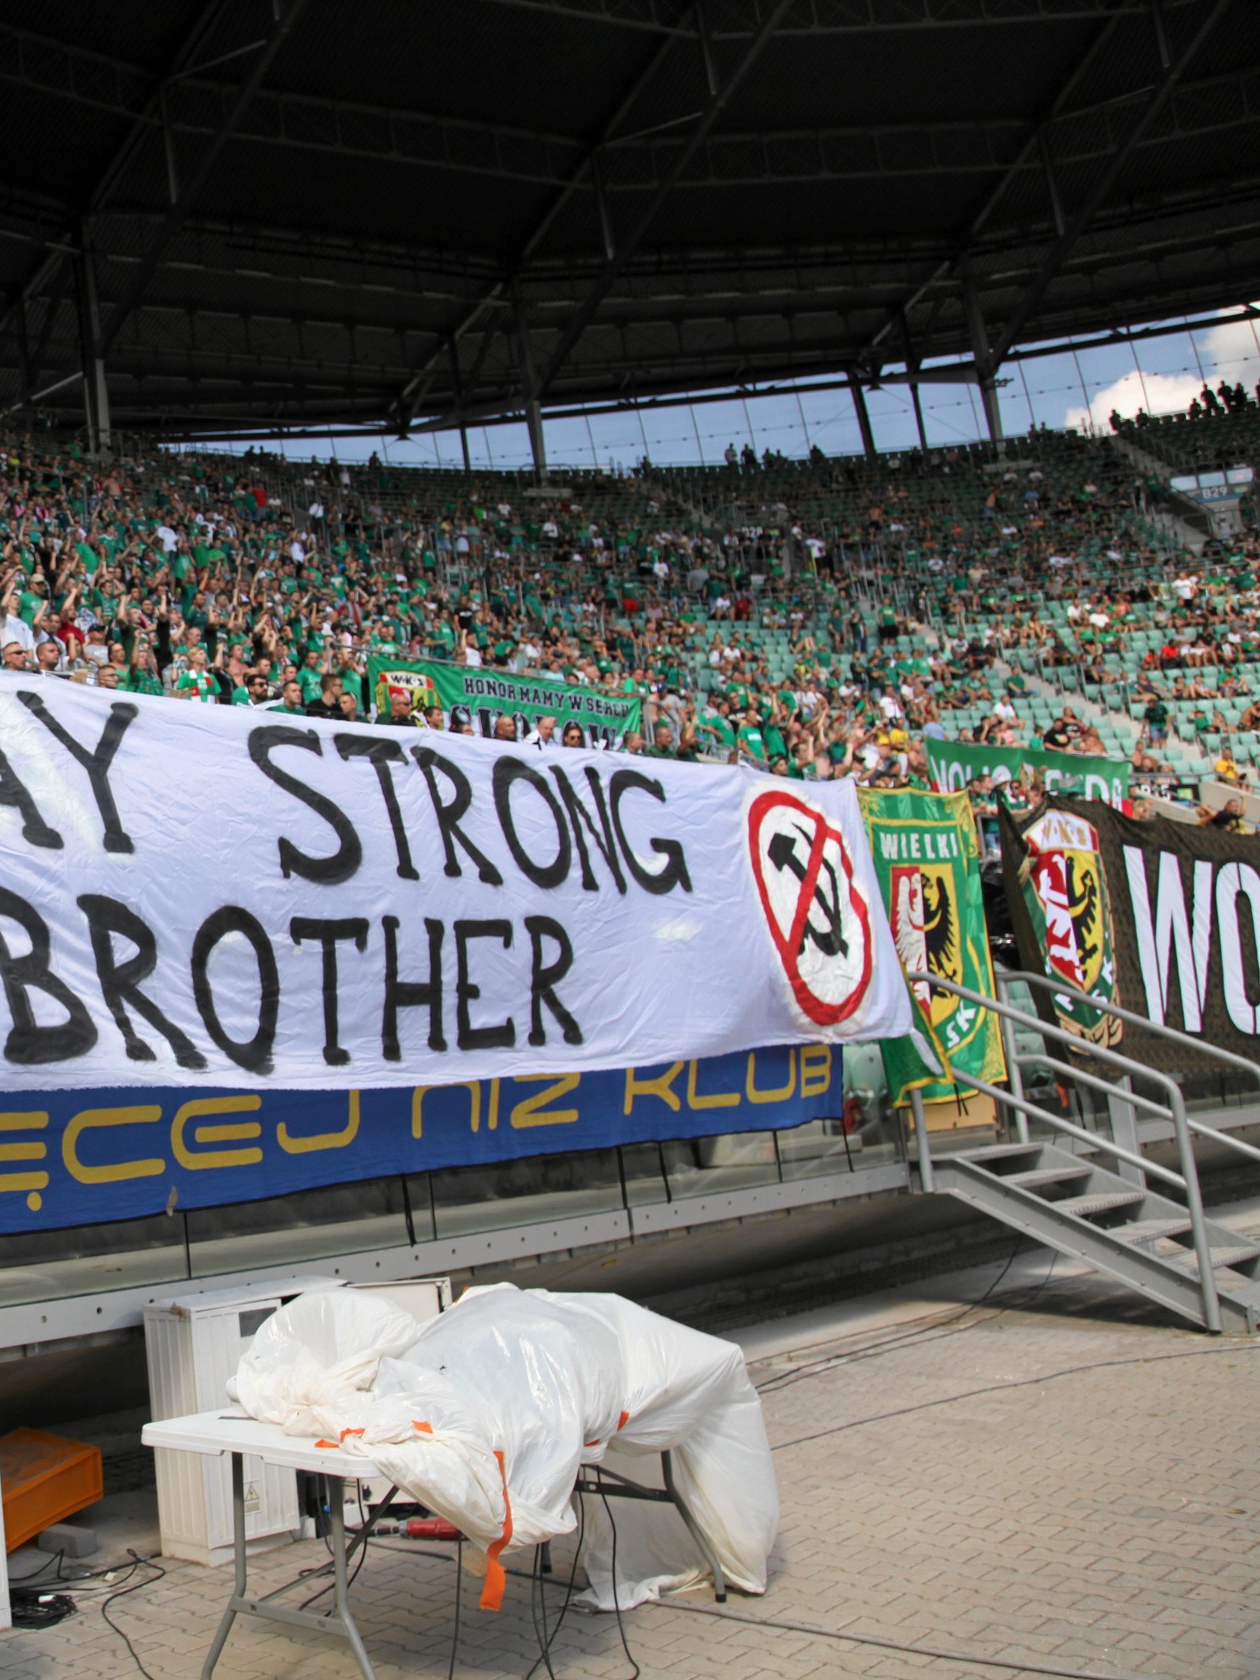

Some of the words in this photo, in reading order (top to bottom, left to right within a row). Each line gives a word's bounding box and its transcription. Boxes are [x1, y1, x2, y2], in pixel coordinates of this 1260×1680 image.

[463, 676, 517, 701] HONOR
[519, 687, 566, 711] MAMY
[568, 693, 584, 712] W
[246, 724, 694, 896] STRONG
[879, 831, 959, 861] WIELKI
[623, 1043, 833, 1116] KLUB
